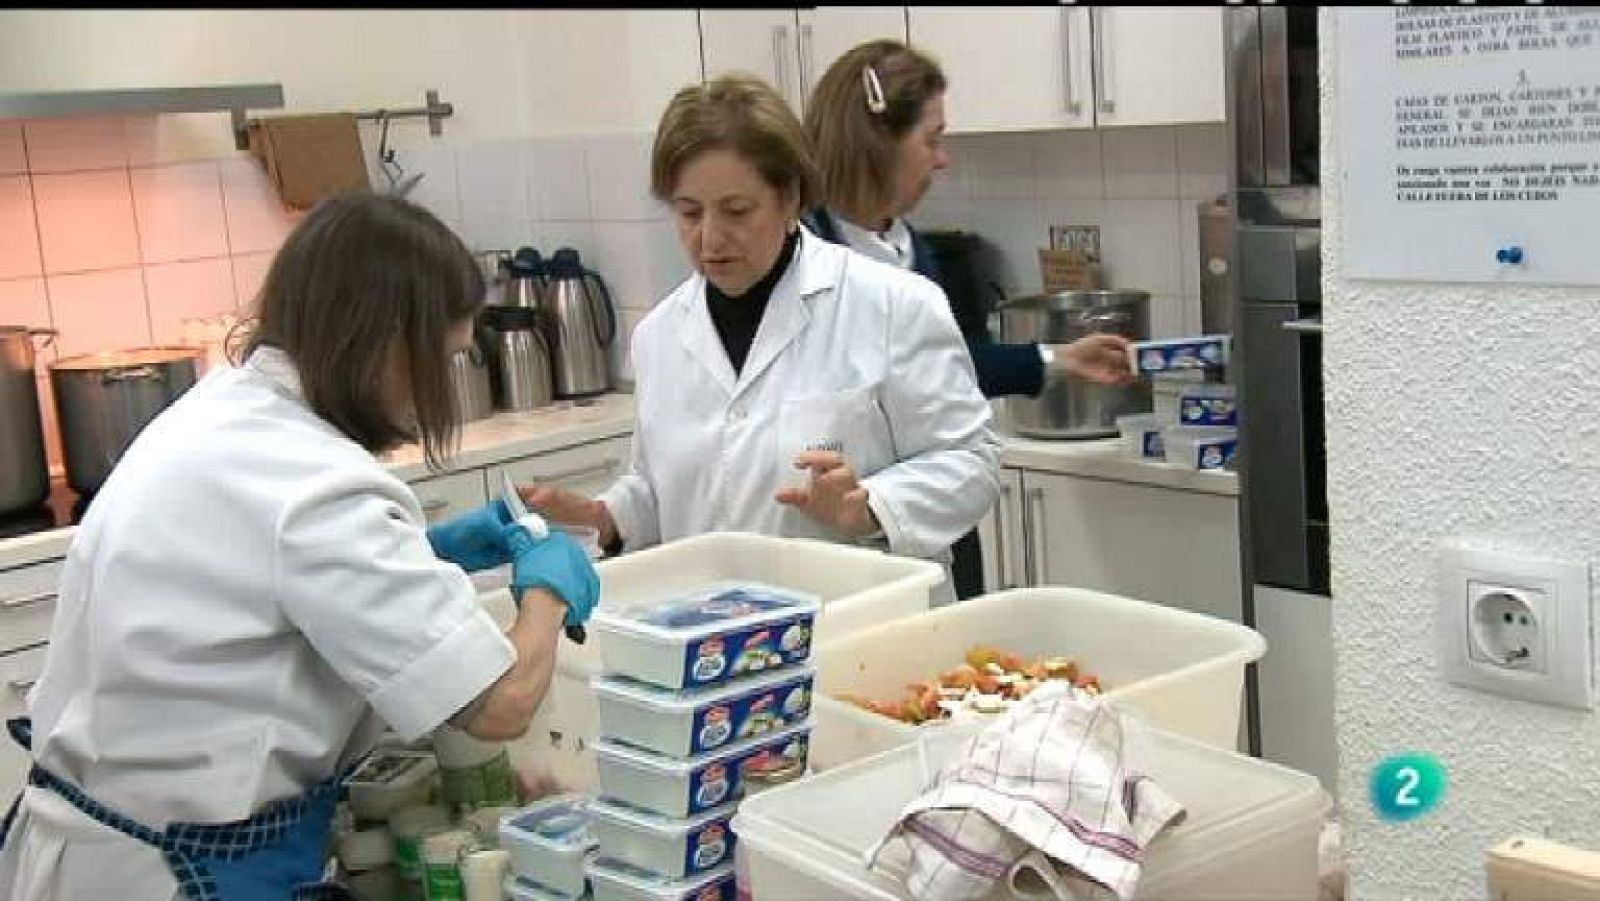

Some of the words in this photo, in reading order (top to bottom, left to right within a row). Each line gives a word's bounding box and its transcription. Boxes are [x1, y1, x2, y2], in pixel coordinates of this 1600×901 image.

[1438, 16, 1452, 28] DE
[1433, 95, 1448, 107] DE
[1502, 176, 1520, 187] NO
[1474, 190, 1489, 201] DE
[1493, 190, 1518, 201] LOS
